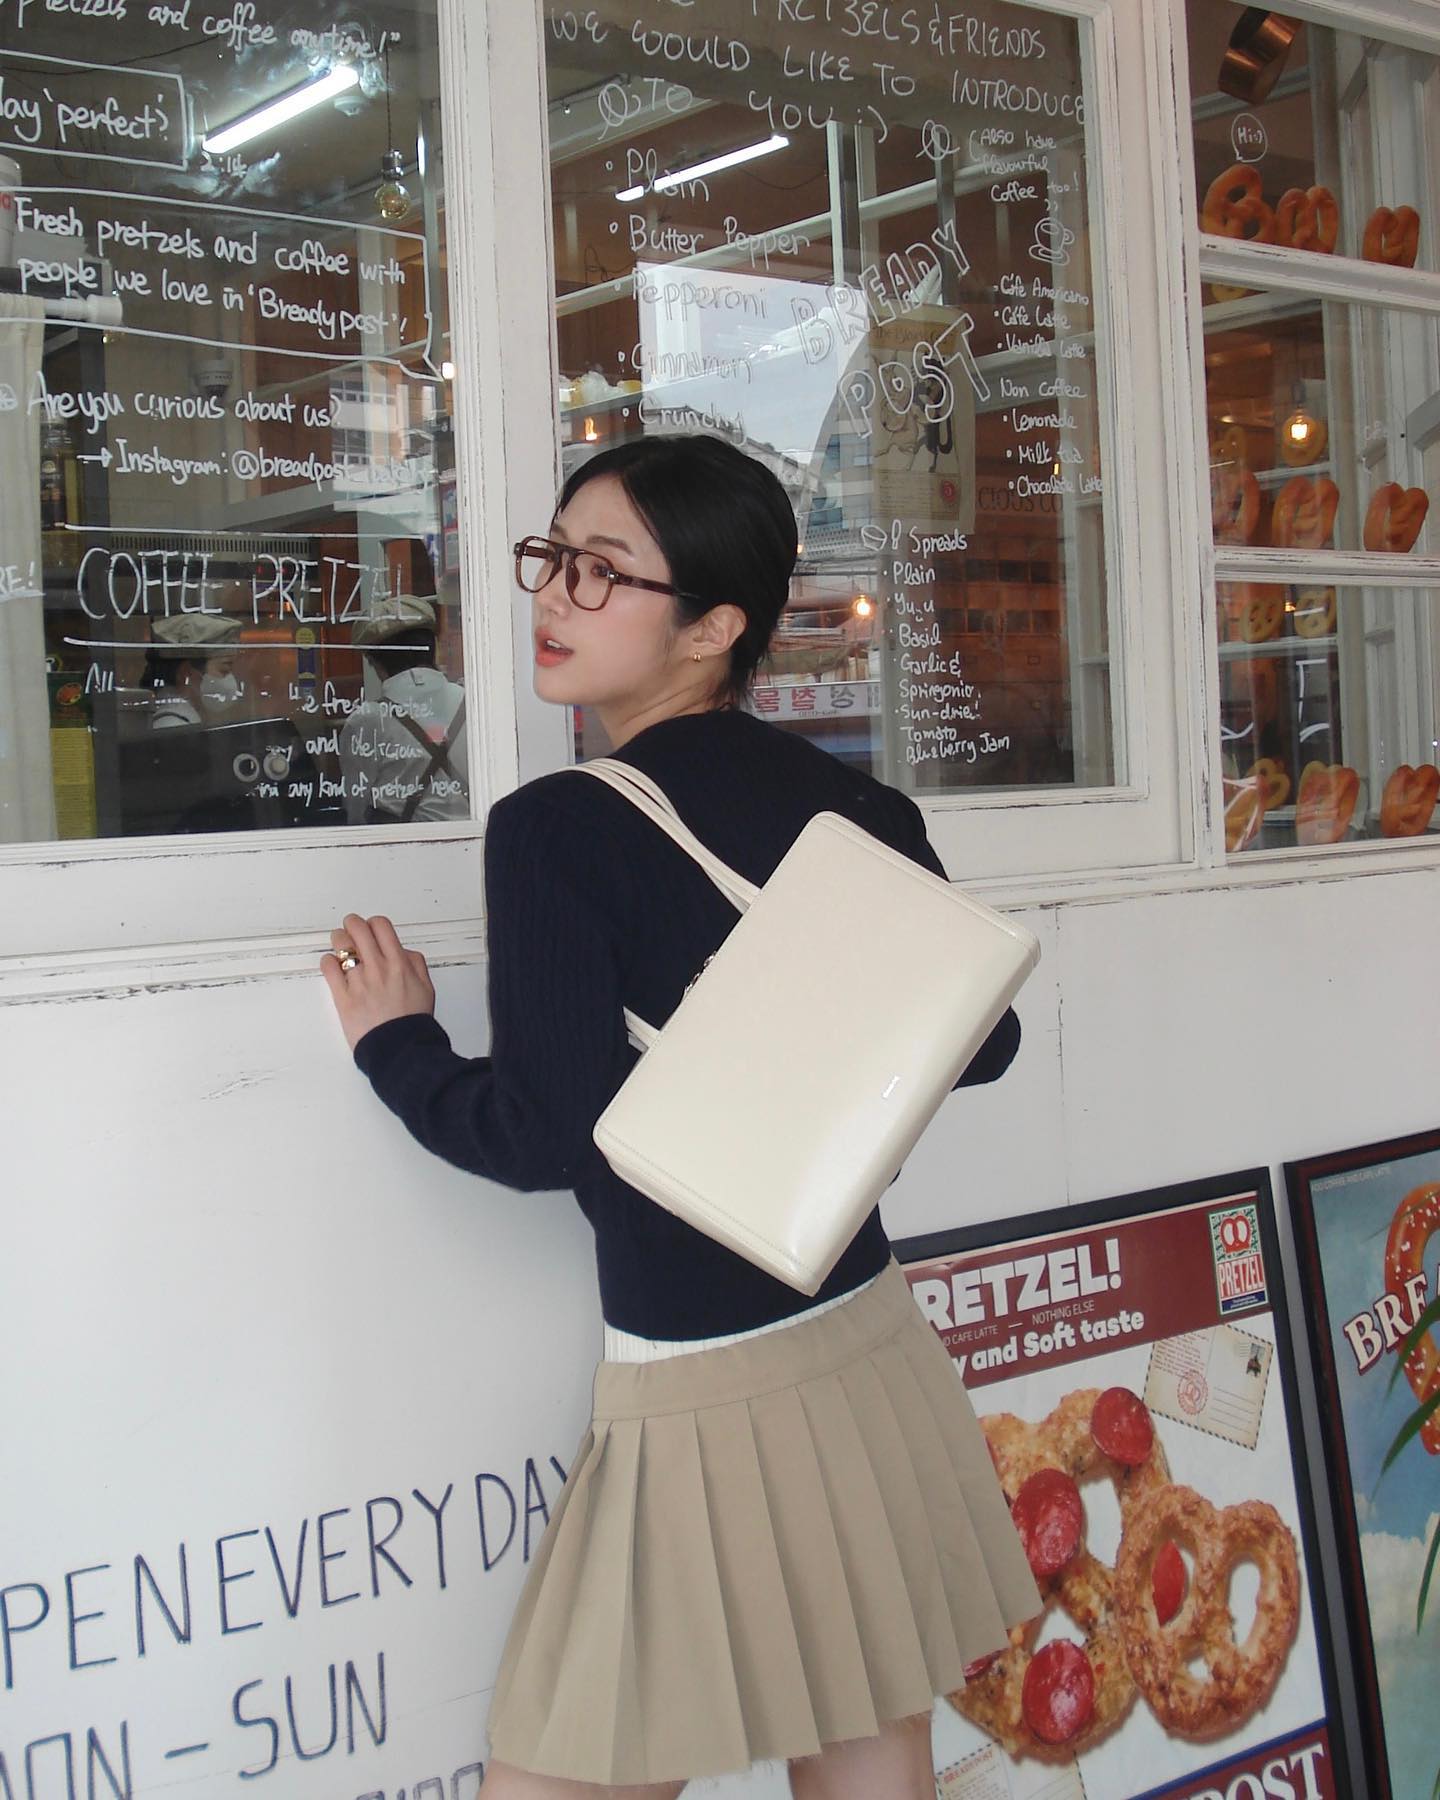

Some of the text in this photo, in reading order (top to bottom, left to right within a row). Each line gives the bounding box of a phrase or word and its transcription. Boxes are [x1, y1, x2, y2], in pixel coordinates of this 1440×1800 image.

[148, 0, 189, 30] and
[202, 2, 277, 50] coffee
[551, 8, 1085, 124] WE WOULD LIKE TO INTRODUCE
[643, 77, 693, 112] TO
[748, 90, 833, 130] YOU
[14, 196, 83, 237] Fresh
[97, 220, 205, 257] pretzels
[214, 231, 257, 264] and
[274, 239, 350, 275] coffee
[360, 258, 405, 285] with
[629, 214, 810, 270] Butter Pepper
[17, 257, 98, 297] people
[114, 270, 151, 295] we
[162, 268, 212, 305] love
[222, 286, 244, 312] in
[632, 267, 768, 322] Pepperoni
[791, 219, 971, 366] BREADY
[839, 312, 990, 439] POST
[1000, 377, 1029, 397] Non
[27, 371, 341, 434] Are you curious about us?
[1012, 408, 1077, 432] Lemonade
[1018, 441, 1052, 464] Milk
[909, 526, 968, 559] Spreads
[893, 561, 936, 585] Plain
[899, 624, 942, 648] Basil
[900, 652, 947, 675] Garlic
[306, 729, 340, 757] and
[900, 726, 957, 743] Tomato
[979, 733, 1010, 753] Jam
[352, 771, 369, 798] of
[1217, 1254, 1265, 1299] PRETZEL
[971, 1336, 1018, 1371] and
[1023, 1322, 1077, 1358] Soft
[1080, 1310, 1145, 1344] taste
[974, 1325, 999, 1339] LATTE
[1032, 1305, 1071, 1326] NOTHING
[1073, 1300, 1096, 1314] ELSE
[233, 1652, 388, 1780] SUN
